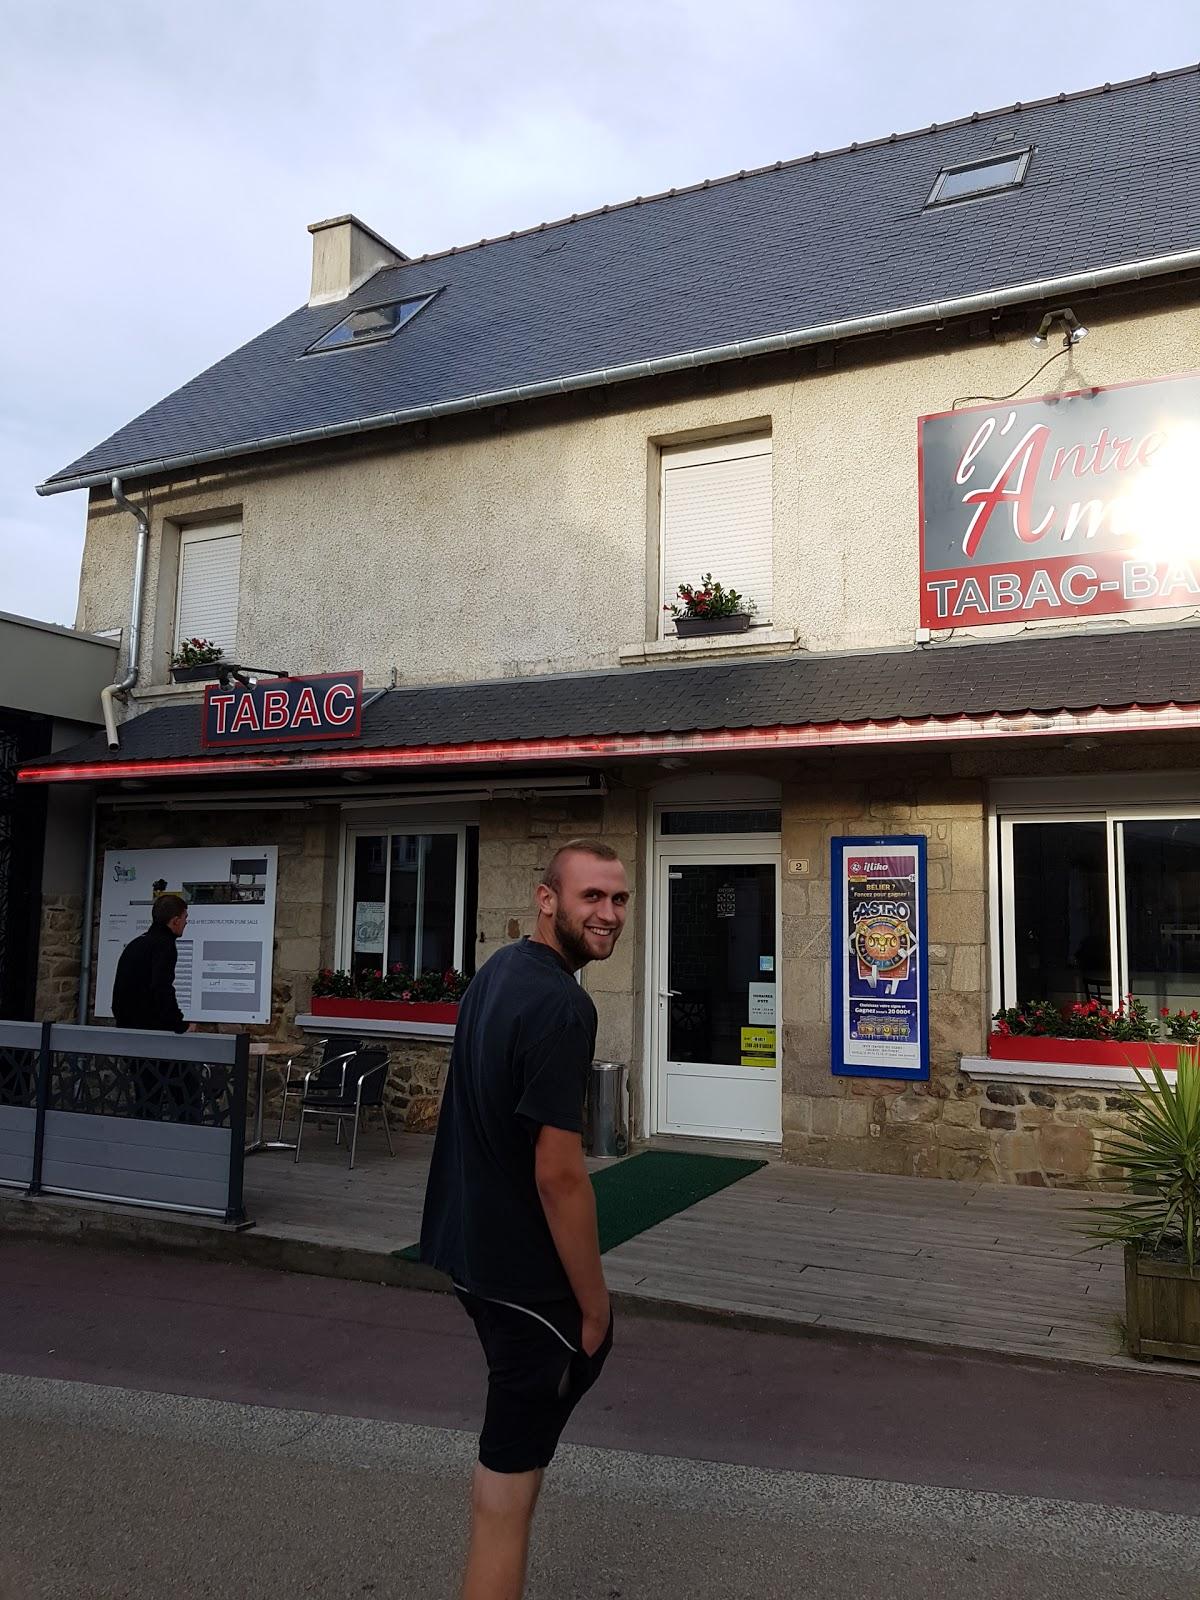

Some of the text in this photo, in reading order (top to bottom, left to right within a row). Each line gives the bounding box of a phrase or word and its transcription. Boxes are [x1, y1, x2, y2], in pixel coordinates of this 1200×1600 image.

[926, 556, 1200, 618] TABAC-BA
[210, 683, 355, 734] TABAC
[795, 862, 802, 871] 2
[853, 900, 911, 924] ASTRO
[854, 1007, 876, 1015] Gagnez
